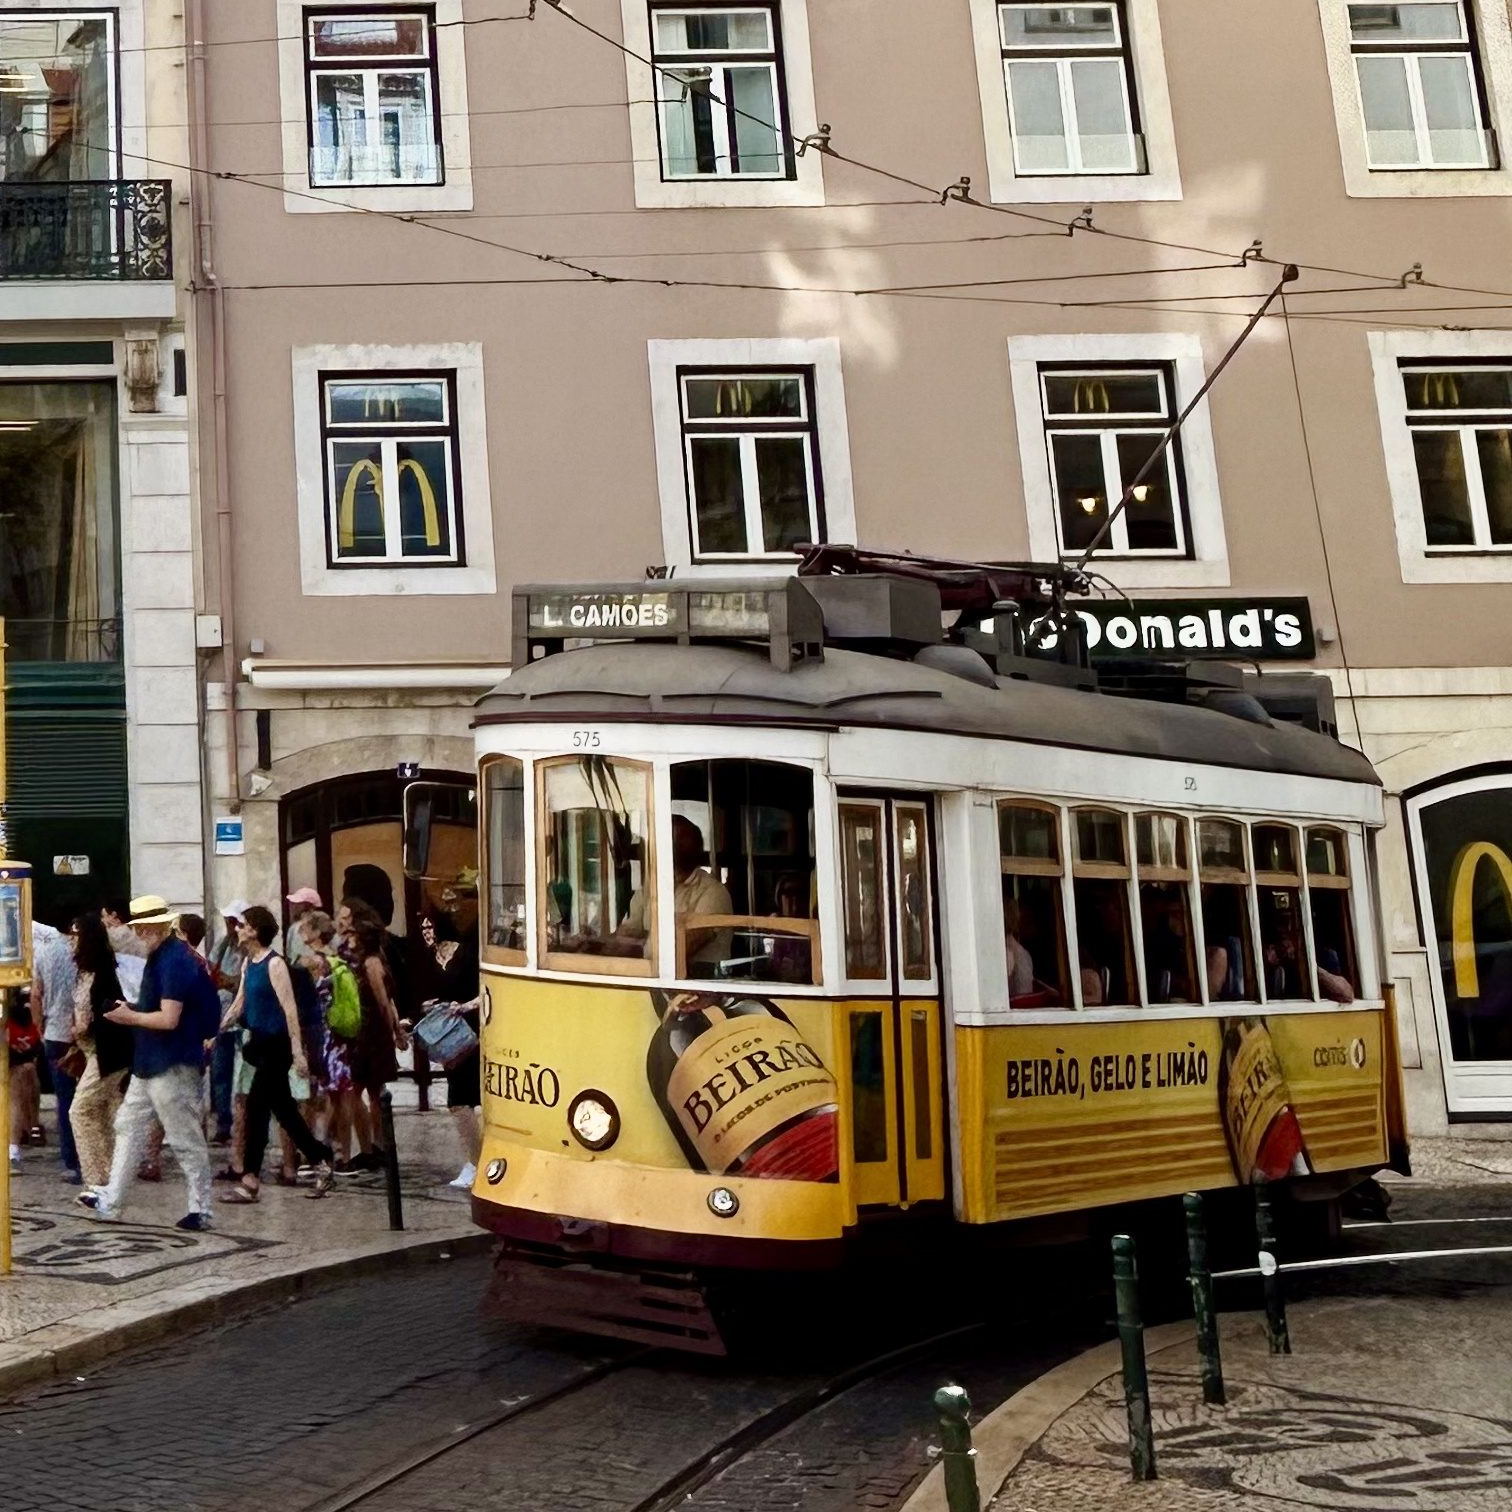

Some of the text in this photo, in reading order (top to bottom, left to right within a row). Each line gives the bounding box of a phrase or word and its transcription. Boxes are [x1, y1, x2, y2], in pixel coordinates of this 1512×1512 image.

[980, 607, 1303, 650] cDonald's
[573, 731, 601, 748] 575
[683, 1039, 825, 1136] BEIRÃO
[1007, 1041, 1209, 1101] BEIRÃO, GELO E LIMÃO
